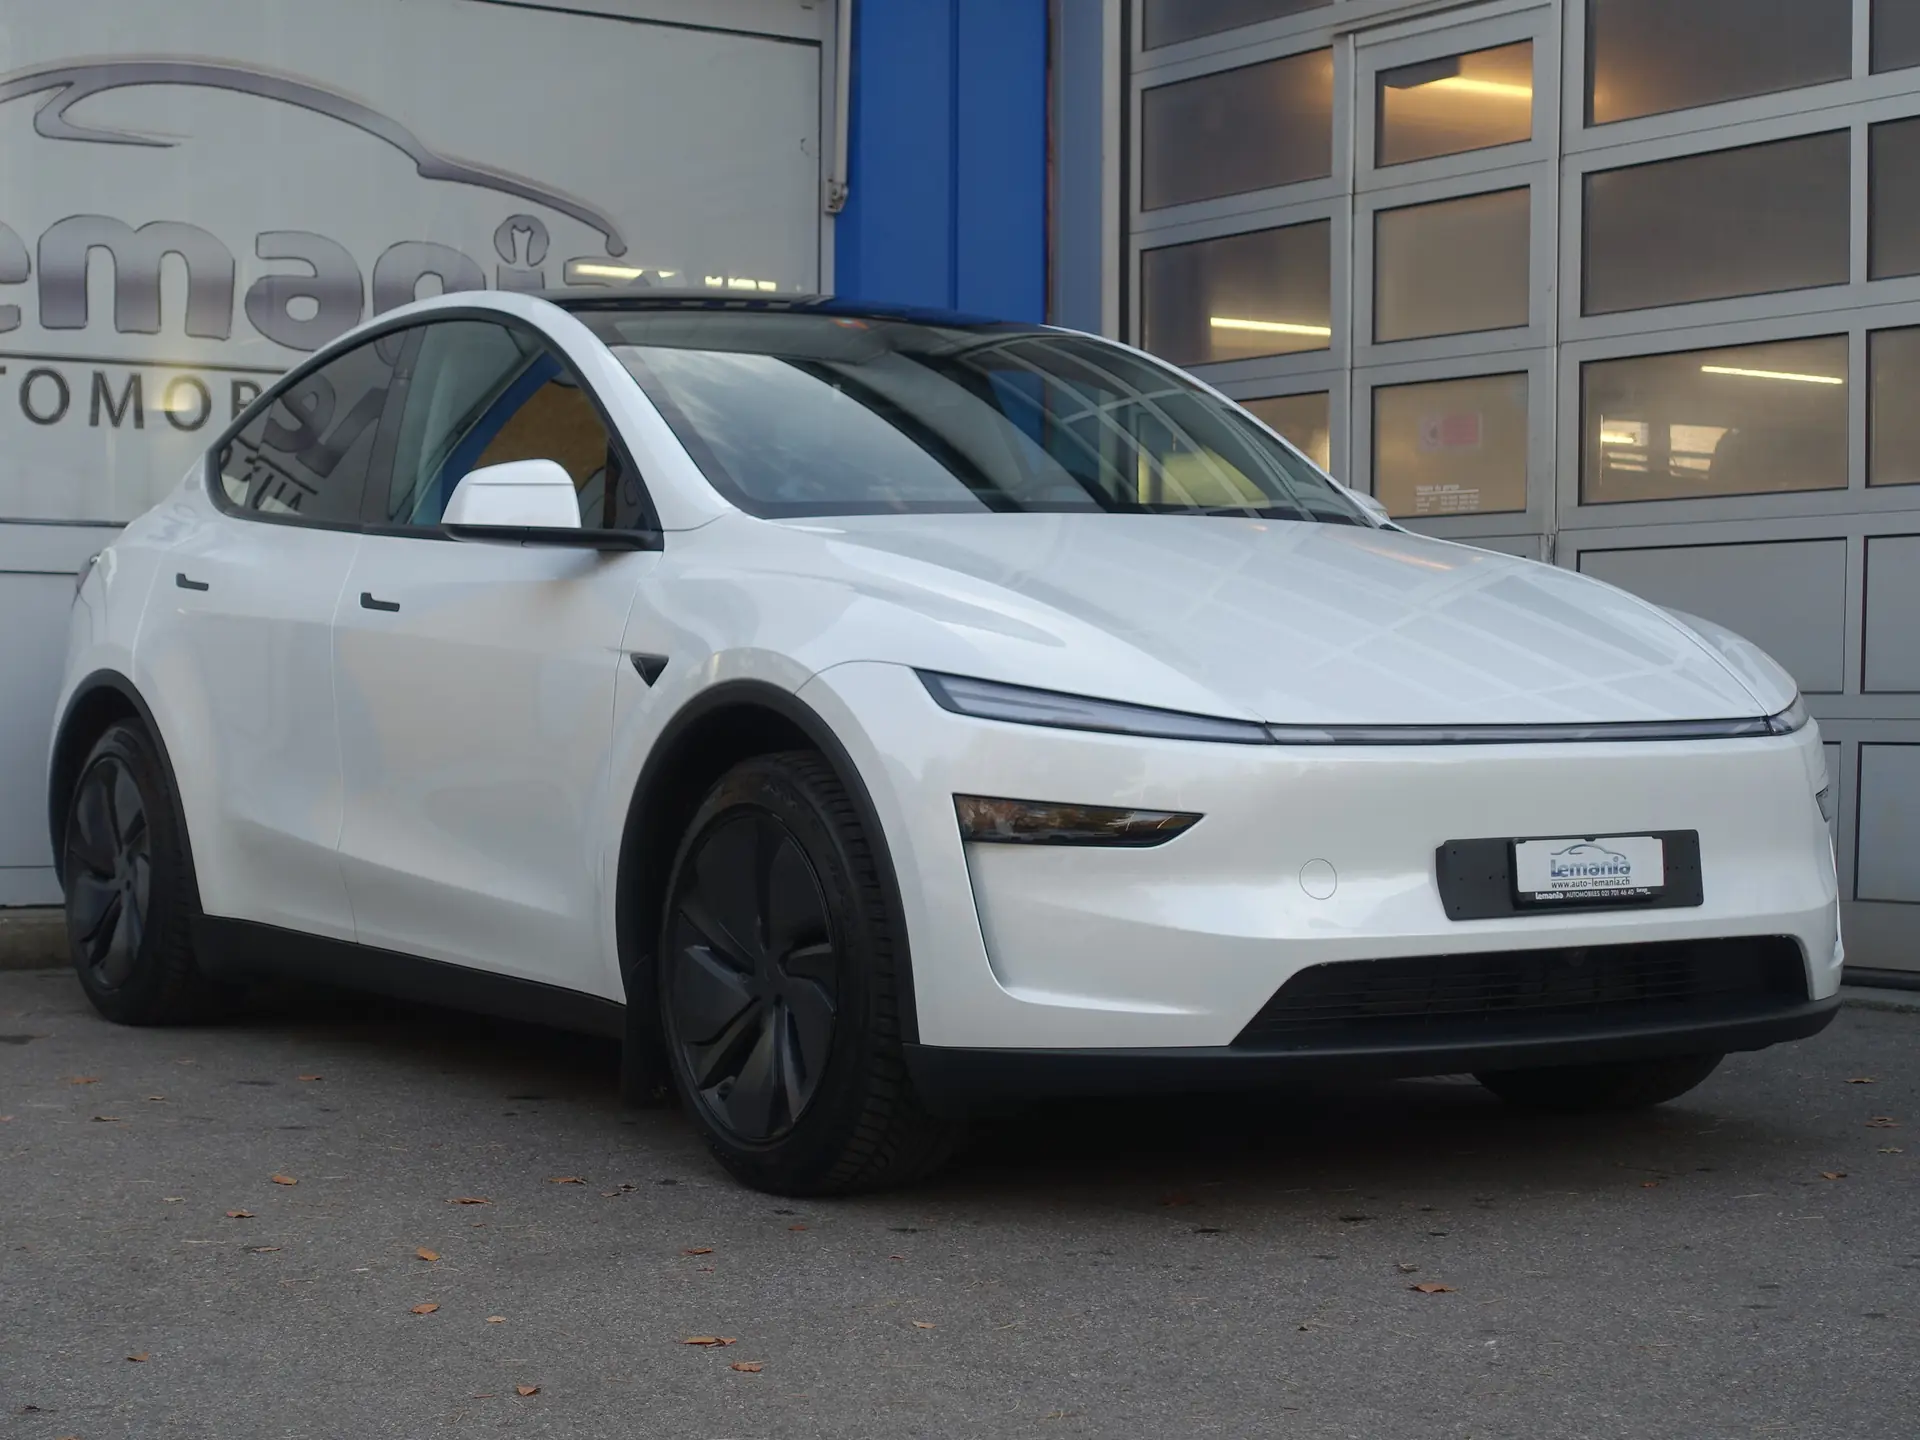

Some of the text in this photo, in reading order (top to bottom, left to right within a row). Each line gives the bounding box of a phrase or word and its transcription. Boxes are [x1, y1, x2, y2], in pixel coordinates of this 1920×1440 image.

[1551, 856, 1630, 877] Lemania
[1551, 877, 1631, 889] www.auto-lemania.ch
[1566, 890, 1600, 898] AUTOMOBILES
